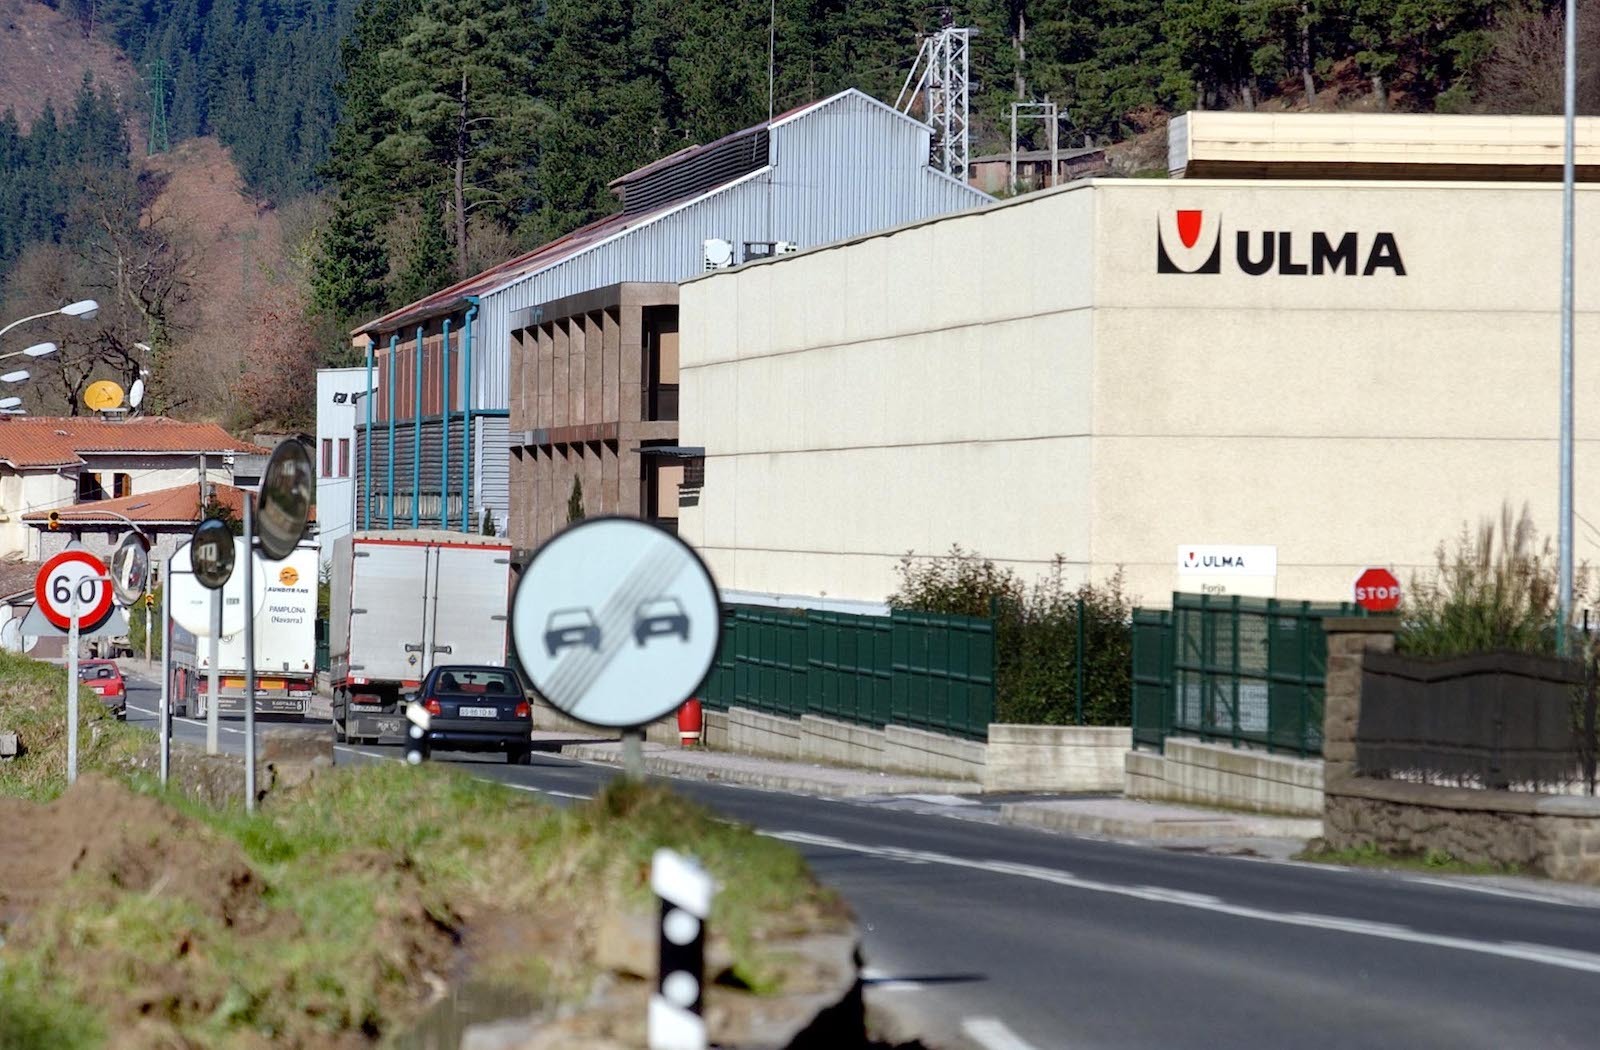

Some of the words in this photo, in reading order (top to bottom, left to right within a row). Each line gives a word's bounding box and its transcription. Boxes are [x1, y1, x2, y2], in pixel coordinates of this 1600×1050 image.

[1236, 231, 1407, 276] ULMA
[1203, 555, 1245, 568] ULMA
[53, 575, 96, 604] 60
[1356, 586, 1400, 601] STOP
[269, 605, 306, 614] PAMPLONA
[271, 615, 303, 624] (Navarra)
